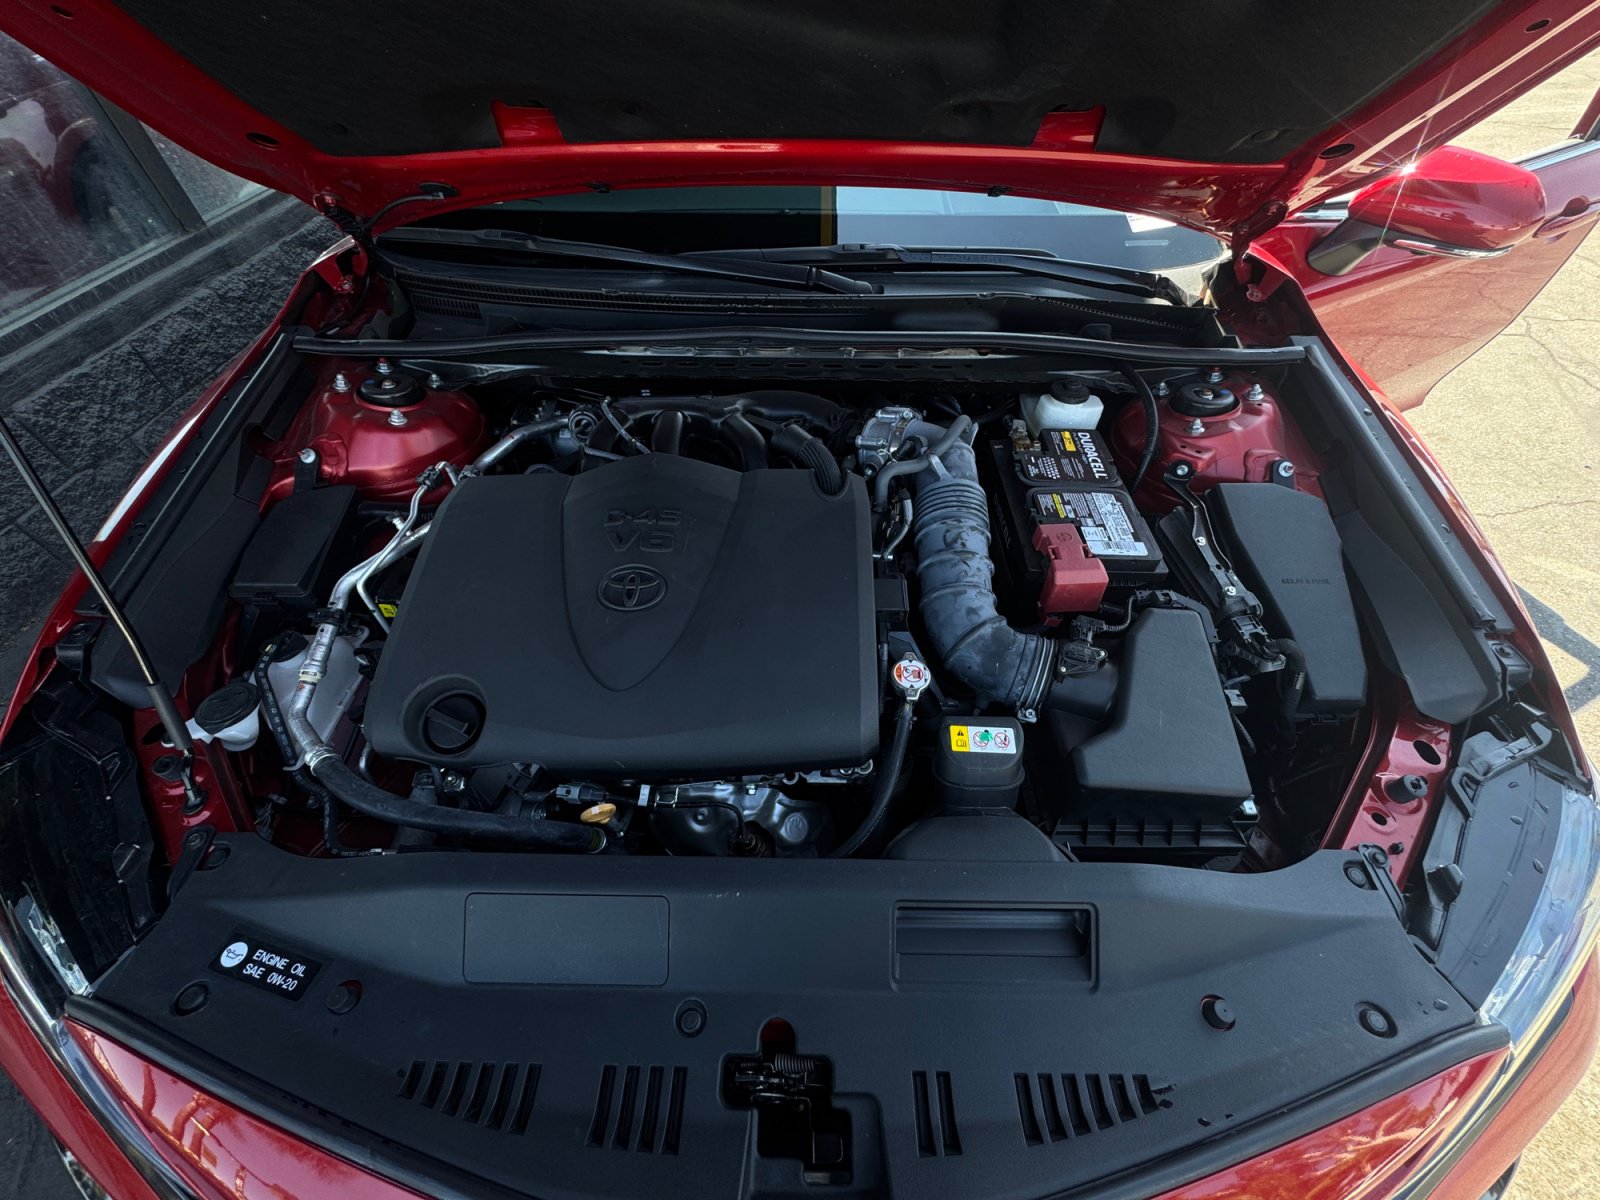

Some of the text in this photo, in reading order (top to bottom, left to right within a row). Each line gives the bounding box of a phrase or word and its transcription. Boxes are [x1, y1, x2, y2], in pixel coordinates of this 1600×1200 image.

[1077, 432, 1108, 479] DURACELL
[606, 528, 674, 553] V6
[243, 963, 298, 991] SAE 0W-20
[253, 949, 306, 978] ENGINE OIL
